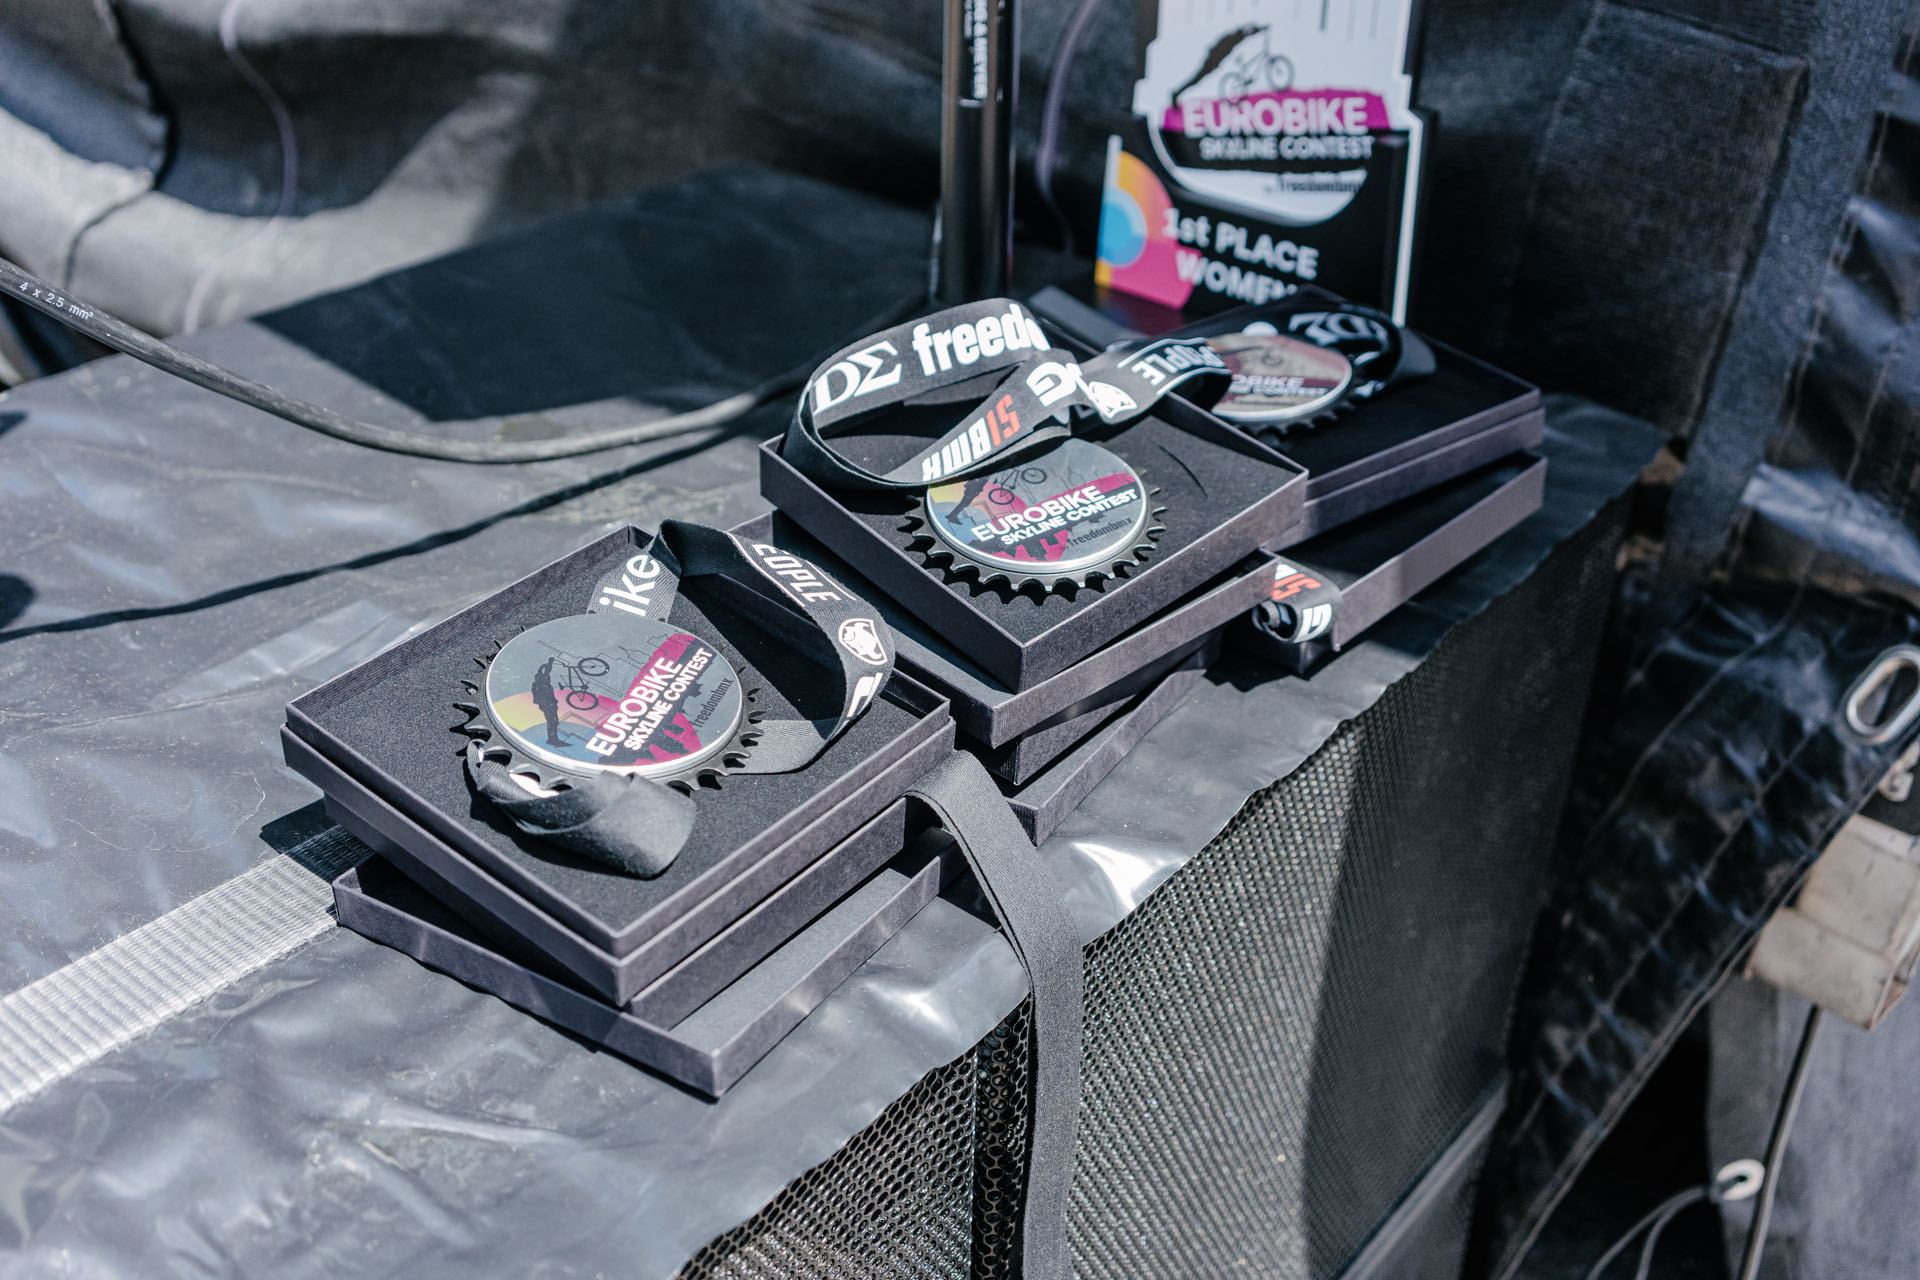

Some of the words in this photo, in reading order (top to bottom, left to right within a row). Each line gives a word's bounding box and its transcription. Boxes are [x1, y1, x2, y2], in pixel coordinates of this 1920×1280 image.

[1184, 98, 1369, 137] EUROBIKE
[1280, 136, 1374, 159] CONTEST
[1163, 207, 1211, 248] 1st
[1215, 221, 1320, 281] PLACE
[19, 281, 29, 292] 4
[45, 293, 65, 308] 2.5
[971, 485, 1105, 542] EUROBIKE
[1000, 515, 1067, 546] SKYLINE
[1069, 488, 1138, 522] CONTEST
[1068, 517, 1132, 547] freedombmx
[600, 554, 661, 617] ike
[585, 657, 684, 757] EUROBIKE
[623, 699, 673, 751] SKYLINE
[663, 647, 713, 701] CONTEST
[692, 678, 735, 728] freedombmx
